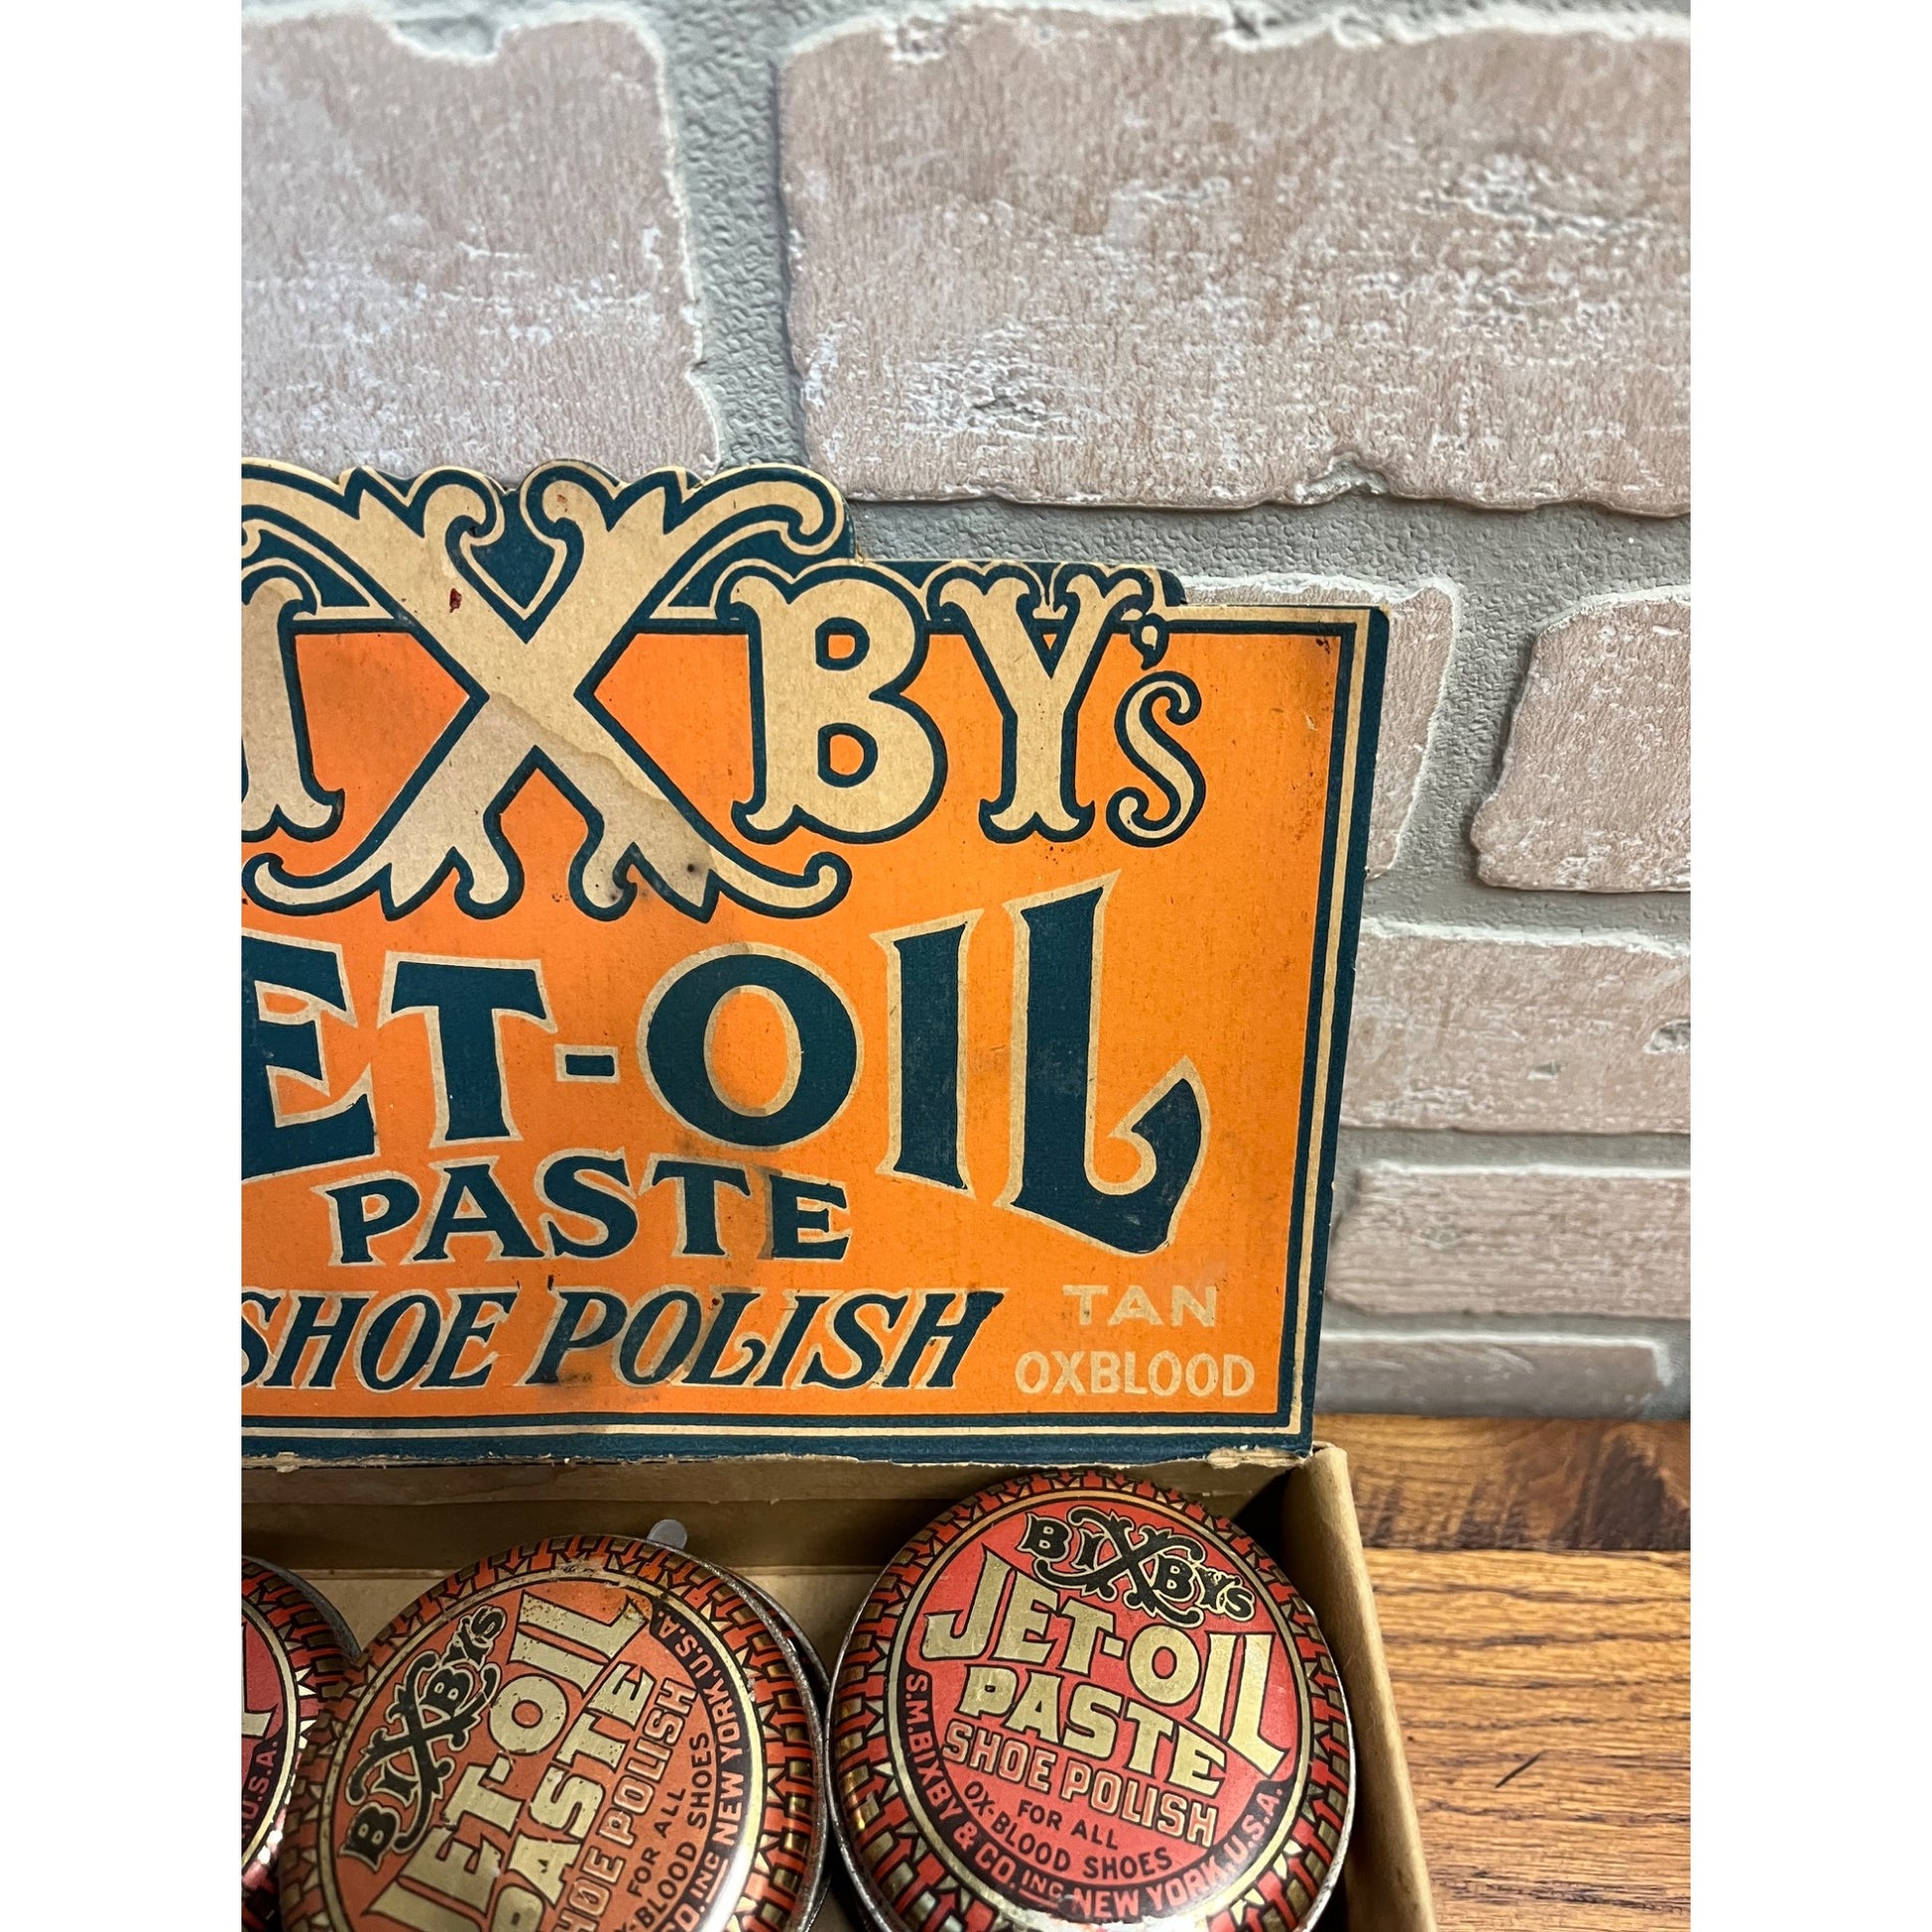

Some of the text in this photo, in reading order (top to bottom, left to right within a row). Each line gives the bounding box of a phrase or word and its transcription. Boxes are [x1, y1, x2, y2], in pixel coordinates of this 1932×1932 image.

[311, 1148, 852, 1266] PASTE
[512, 1287, 1009, 1390] POLISH
[1062, 1285, 1217, 1327] TAN
[1015, 1350, 1255, 1397] OXBLOOD
[920, 1544, 1291, 1777] JET-OIL
[596, 1677, 697, 1849] POLISH
[687, 1732, 713, 1830] SHOES
[956, 1665, 1226, 1797] PASTE
[712, 1770, 745, 1847] NEW
[942, 1719, 1219, 1850] SHOE POLISH
[964, 1780, 1173, 1879] OX-BLOOD SHOES
[1018, 1799, 1119, 1851] FOR ALL
[627, 1788, 686, 1897] FOR ALL
[953, 1822, 978, 1851] &
[1071, 1885, 1139, 1919] NEW
